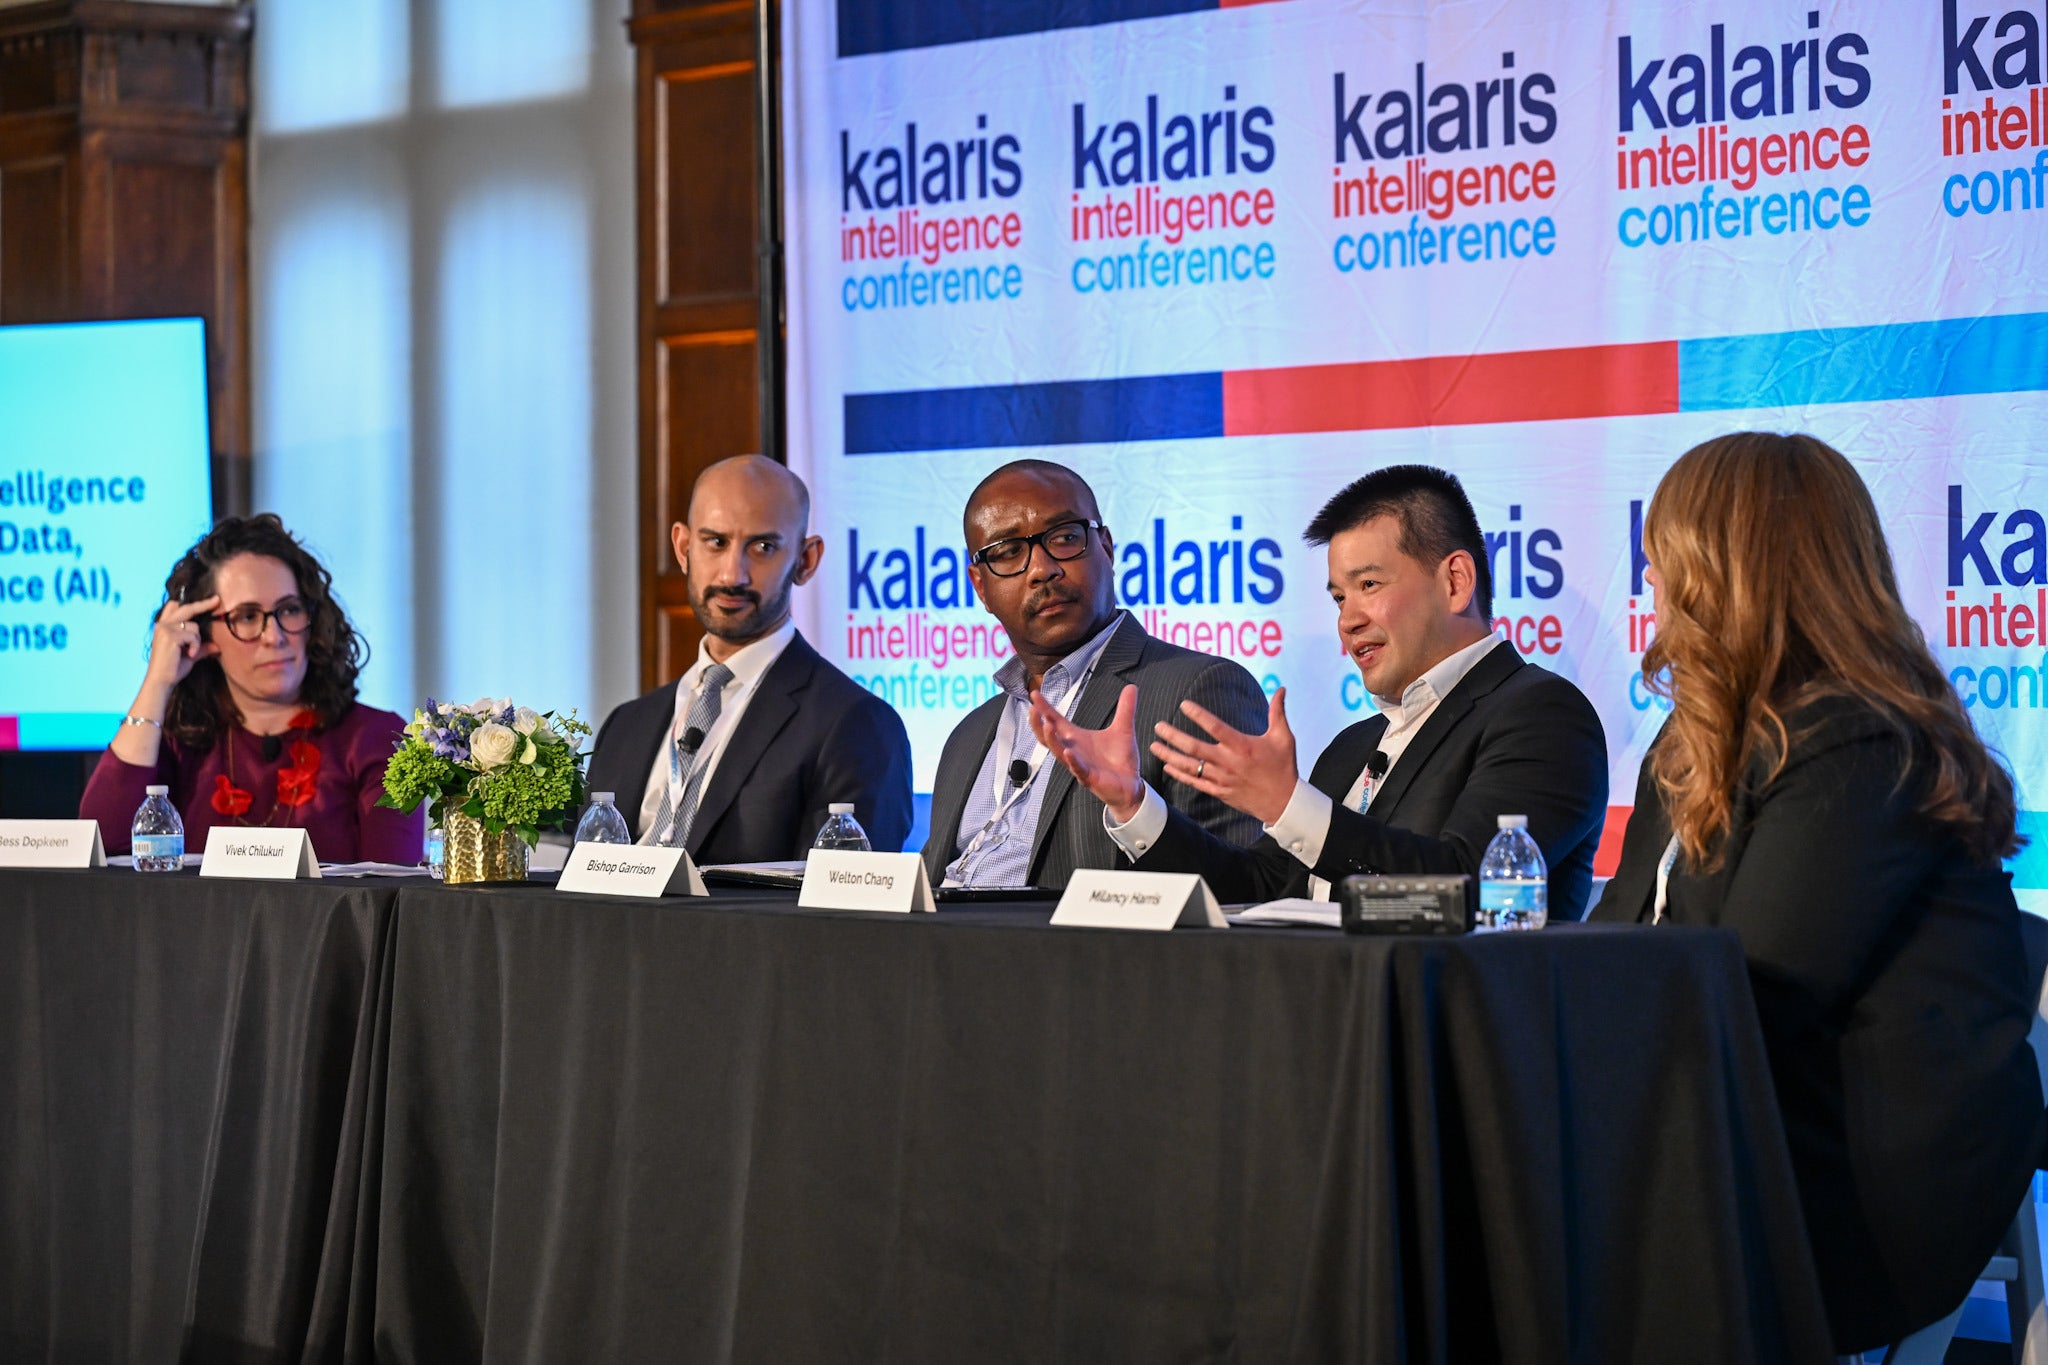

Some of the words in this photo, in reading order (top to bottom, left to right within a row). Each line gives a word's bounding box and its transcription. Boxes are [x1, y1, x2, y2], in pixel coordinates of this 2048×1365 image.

[1617, 10, 1872, 134] kalaris
[1332, 51, 1558, 163] kalaris
[840, 114, 1023, 213] kalaris
[1072, 85, 1277, 190] kalaris
[1616, 123, 1871, 193] intelligence
[1071, 186, 1276, 245] intelligence
[1332, 157, 1557, 220] intelligence
[1617, 183, 1872, 249] conference
[841, 211, 1022, 265] intelligence
[1072, 239, 1276, 294] conference
[1333, 214, 1557, 273] conference
[842, 261, 1023, 312] conference
[54, 566, 121, 608] (AI),
[1114, 516, 1285, 607] alaris
[847, 613, 1018, 670] intelligenc
[22, 836, 69, 849] Dopkeen
[225, 844, 247, 856] Vivek
[248, 845, 285, 857] Chilukuri
[587, 859, 617, 875] Bishop
[619, 862, 656, 875] Garrison
[829, 870, 862, 884] Welton
[864, 872, 894, 889] Chang
[1130, 891, 1162, 905] Harris
